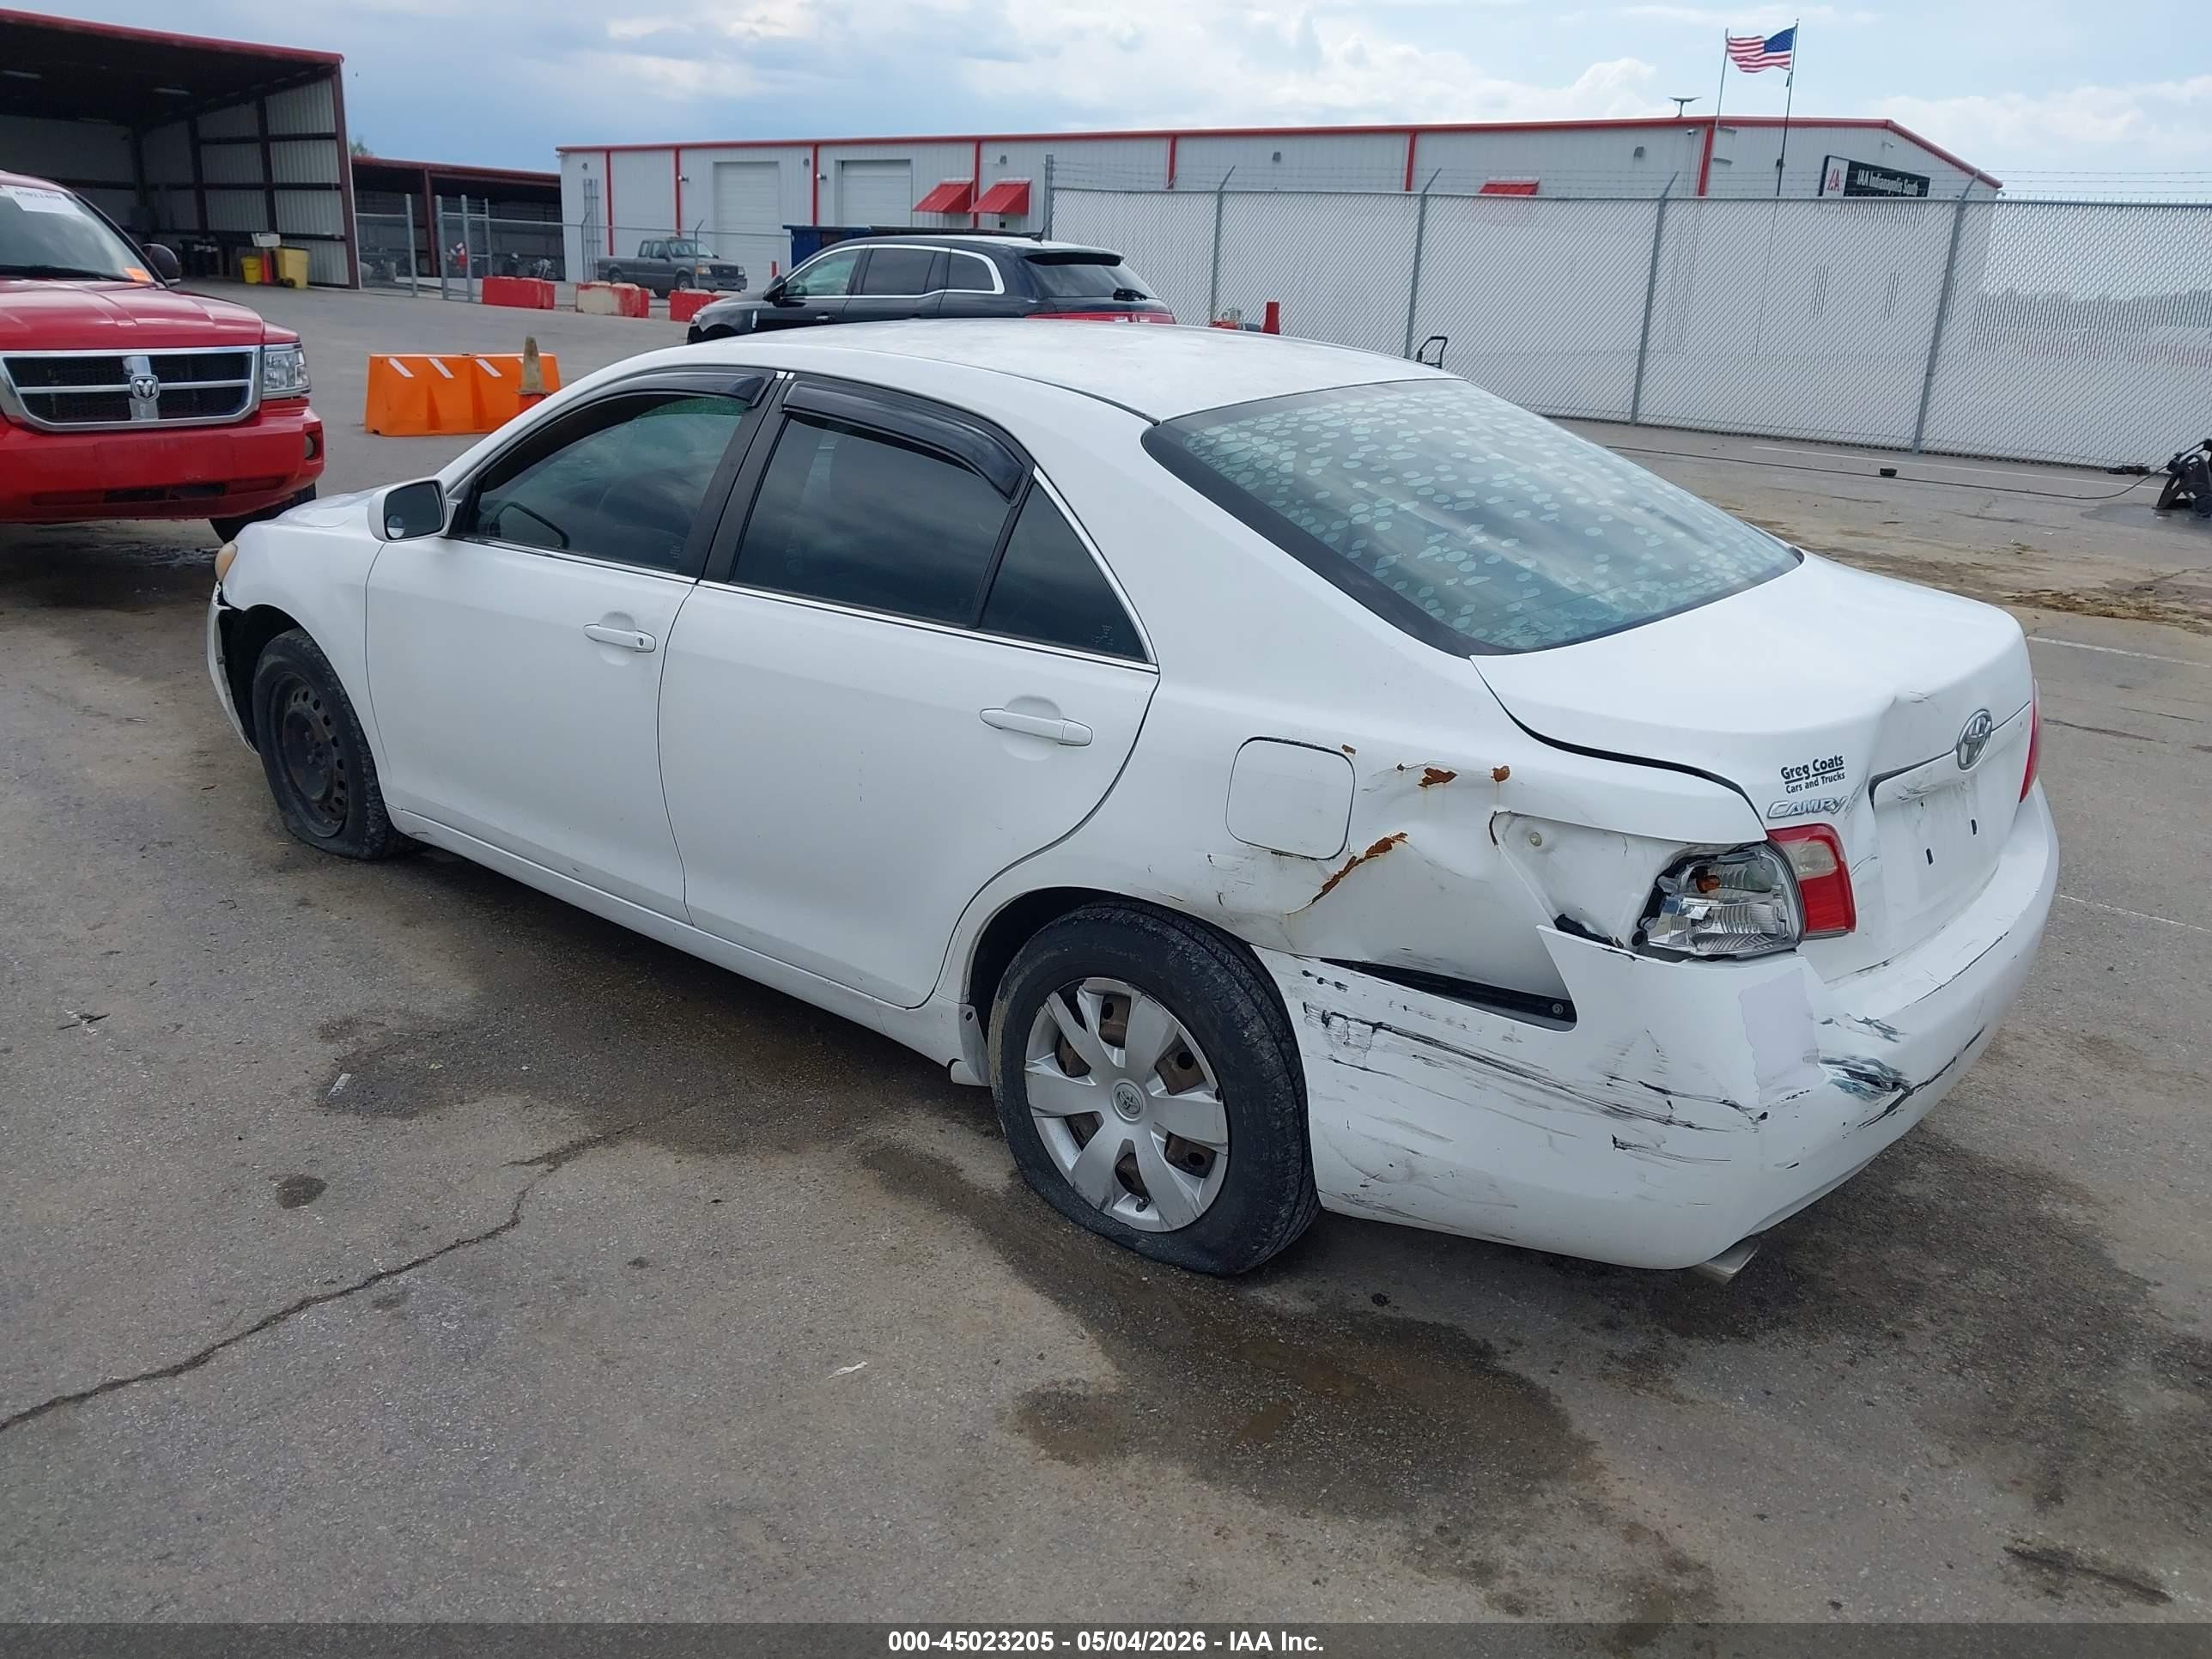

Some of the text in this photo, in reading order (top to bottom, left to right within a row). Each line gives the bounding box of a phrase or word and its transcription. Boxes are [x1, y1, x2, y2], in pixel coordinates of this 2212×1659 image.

[1856, 168, 1918, 196] IAA Indianapolis South
[1780, 755, 1844, 781] Greg Coats
[1785, 771, 1846, 794] Cars and Trucks
[1767, 795, 1849, 819] CAMRY
